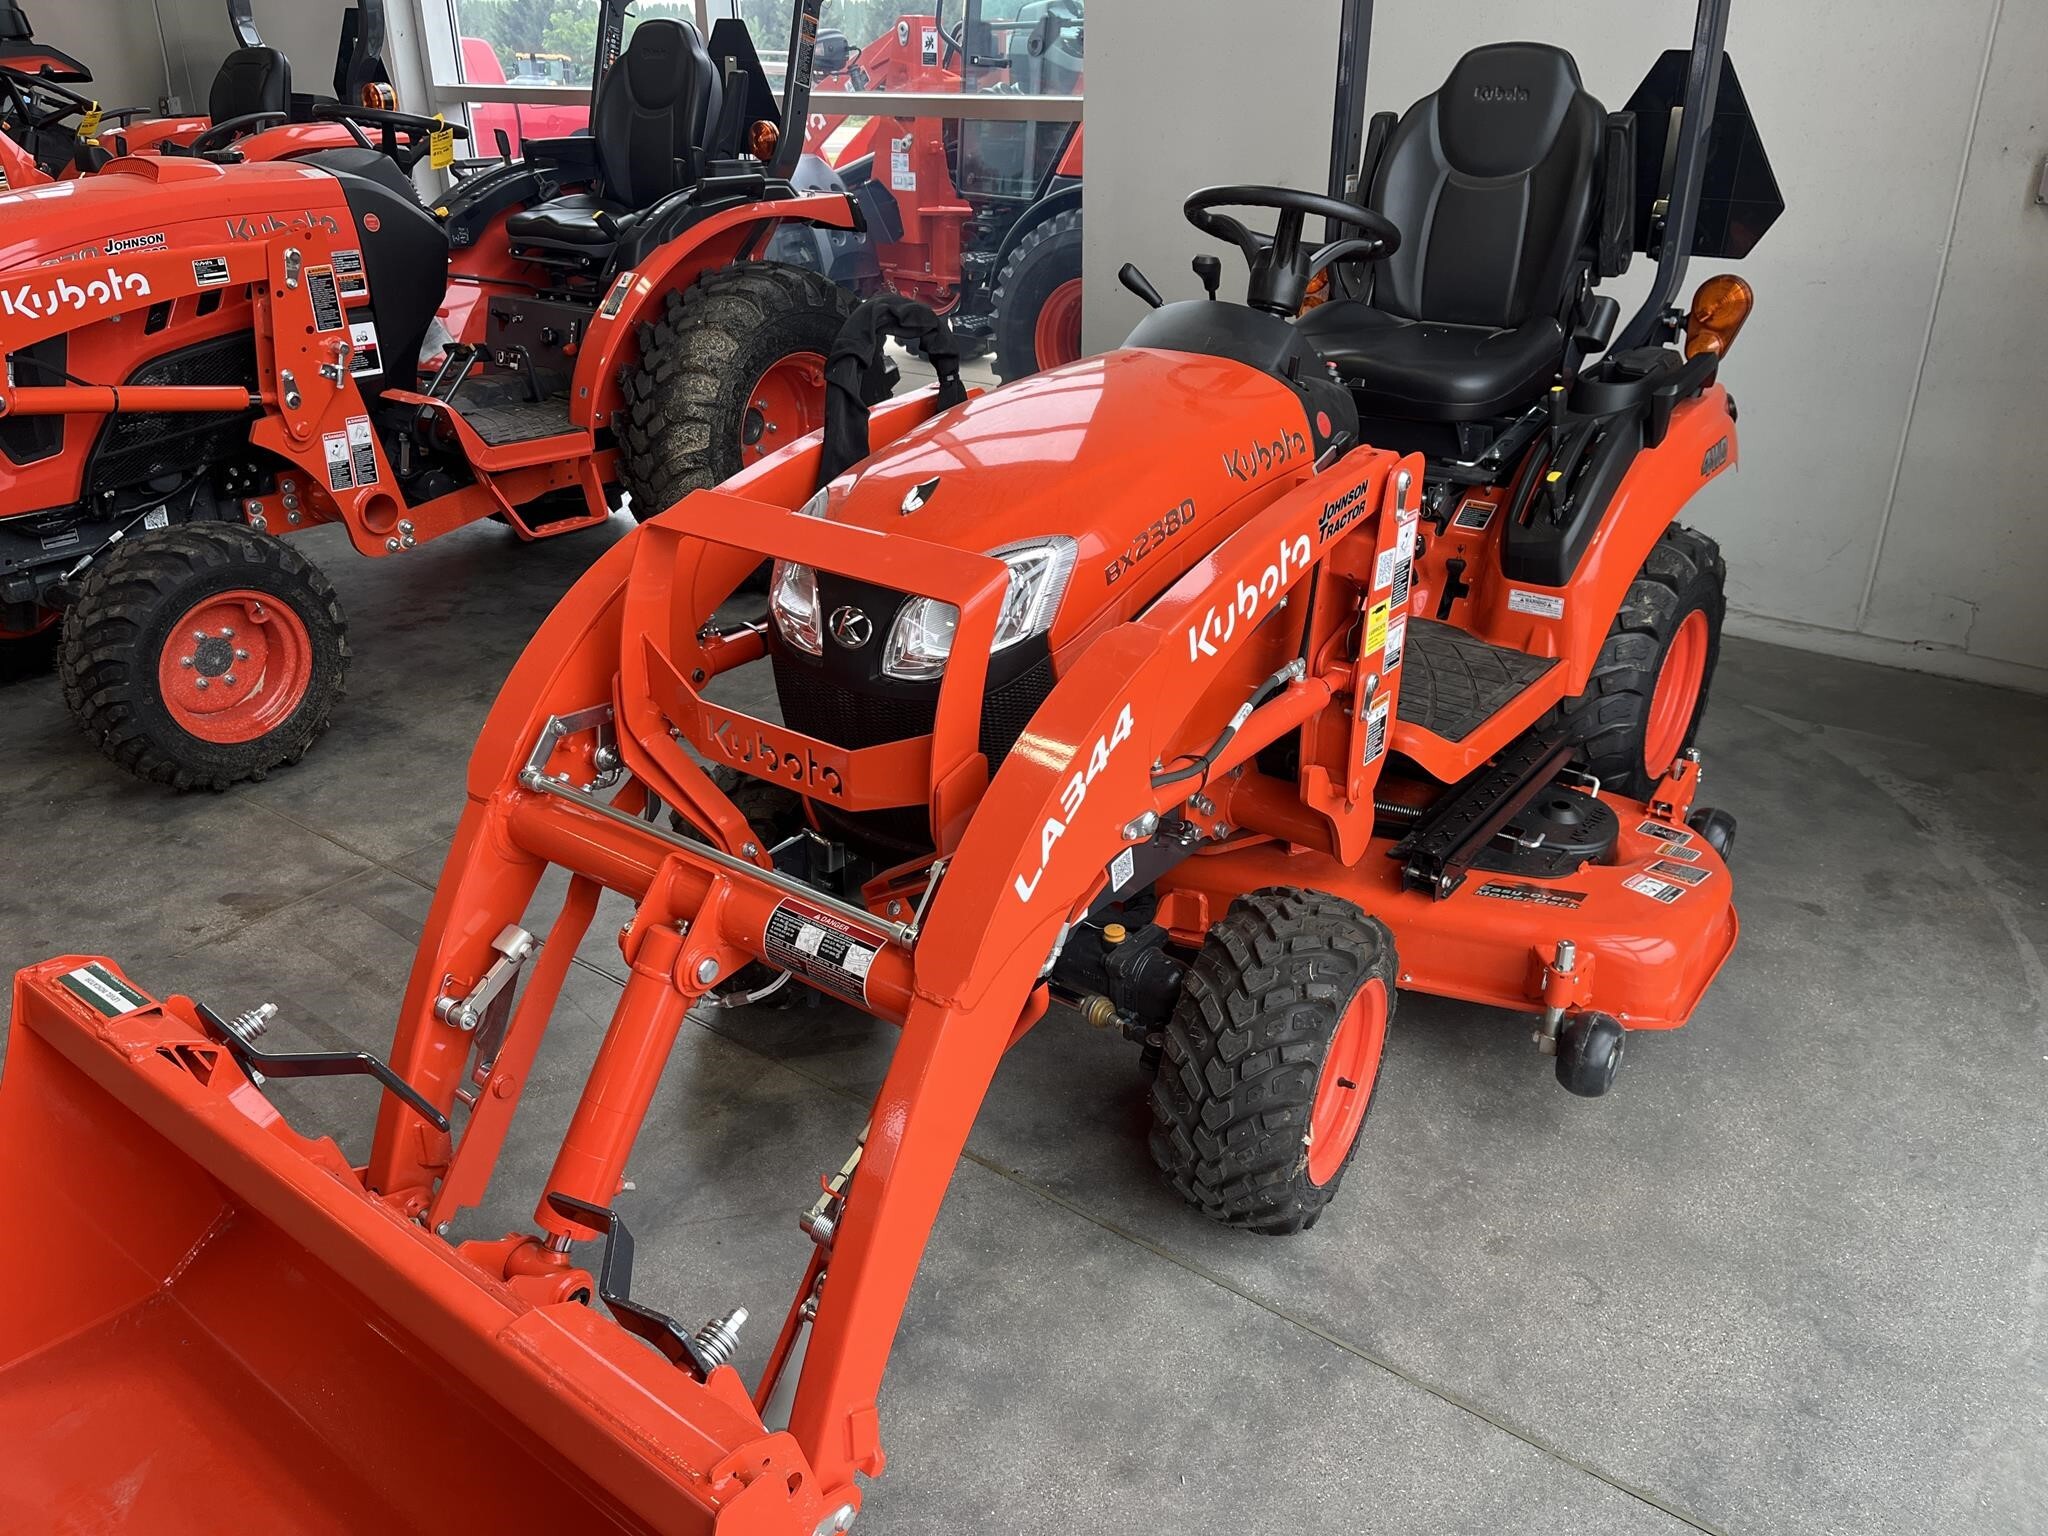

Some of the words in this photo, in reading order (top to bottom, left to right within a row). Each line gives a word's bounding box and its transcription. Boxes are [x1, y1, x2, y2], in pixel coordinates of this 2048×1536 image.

[1474, 85, 1529, 102] Kubota
[105, 233, 165, 252] JOHNSON
[1, 268, 151, 319] Kubota
[1223, 427, 1306, 481] Kubota
[1319, 480, 1369, 525] JOHNSON
[1319, 500, 1366, 544] TRACTOR
[1188, 534, 1311, 662] Kubota
[706, 713, 843, 798] Kubota
[1014, 703, 1135, 903] LA344
[1474, 889, 1531, 903] Mower
[1534, 897, 1581, 910] Deck
[1479, 885, 1570, 902] Easy-over
[820, 916, 850, 932] DANGER
